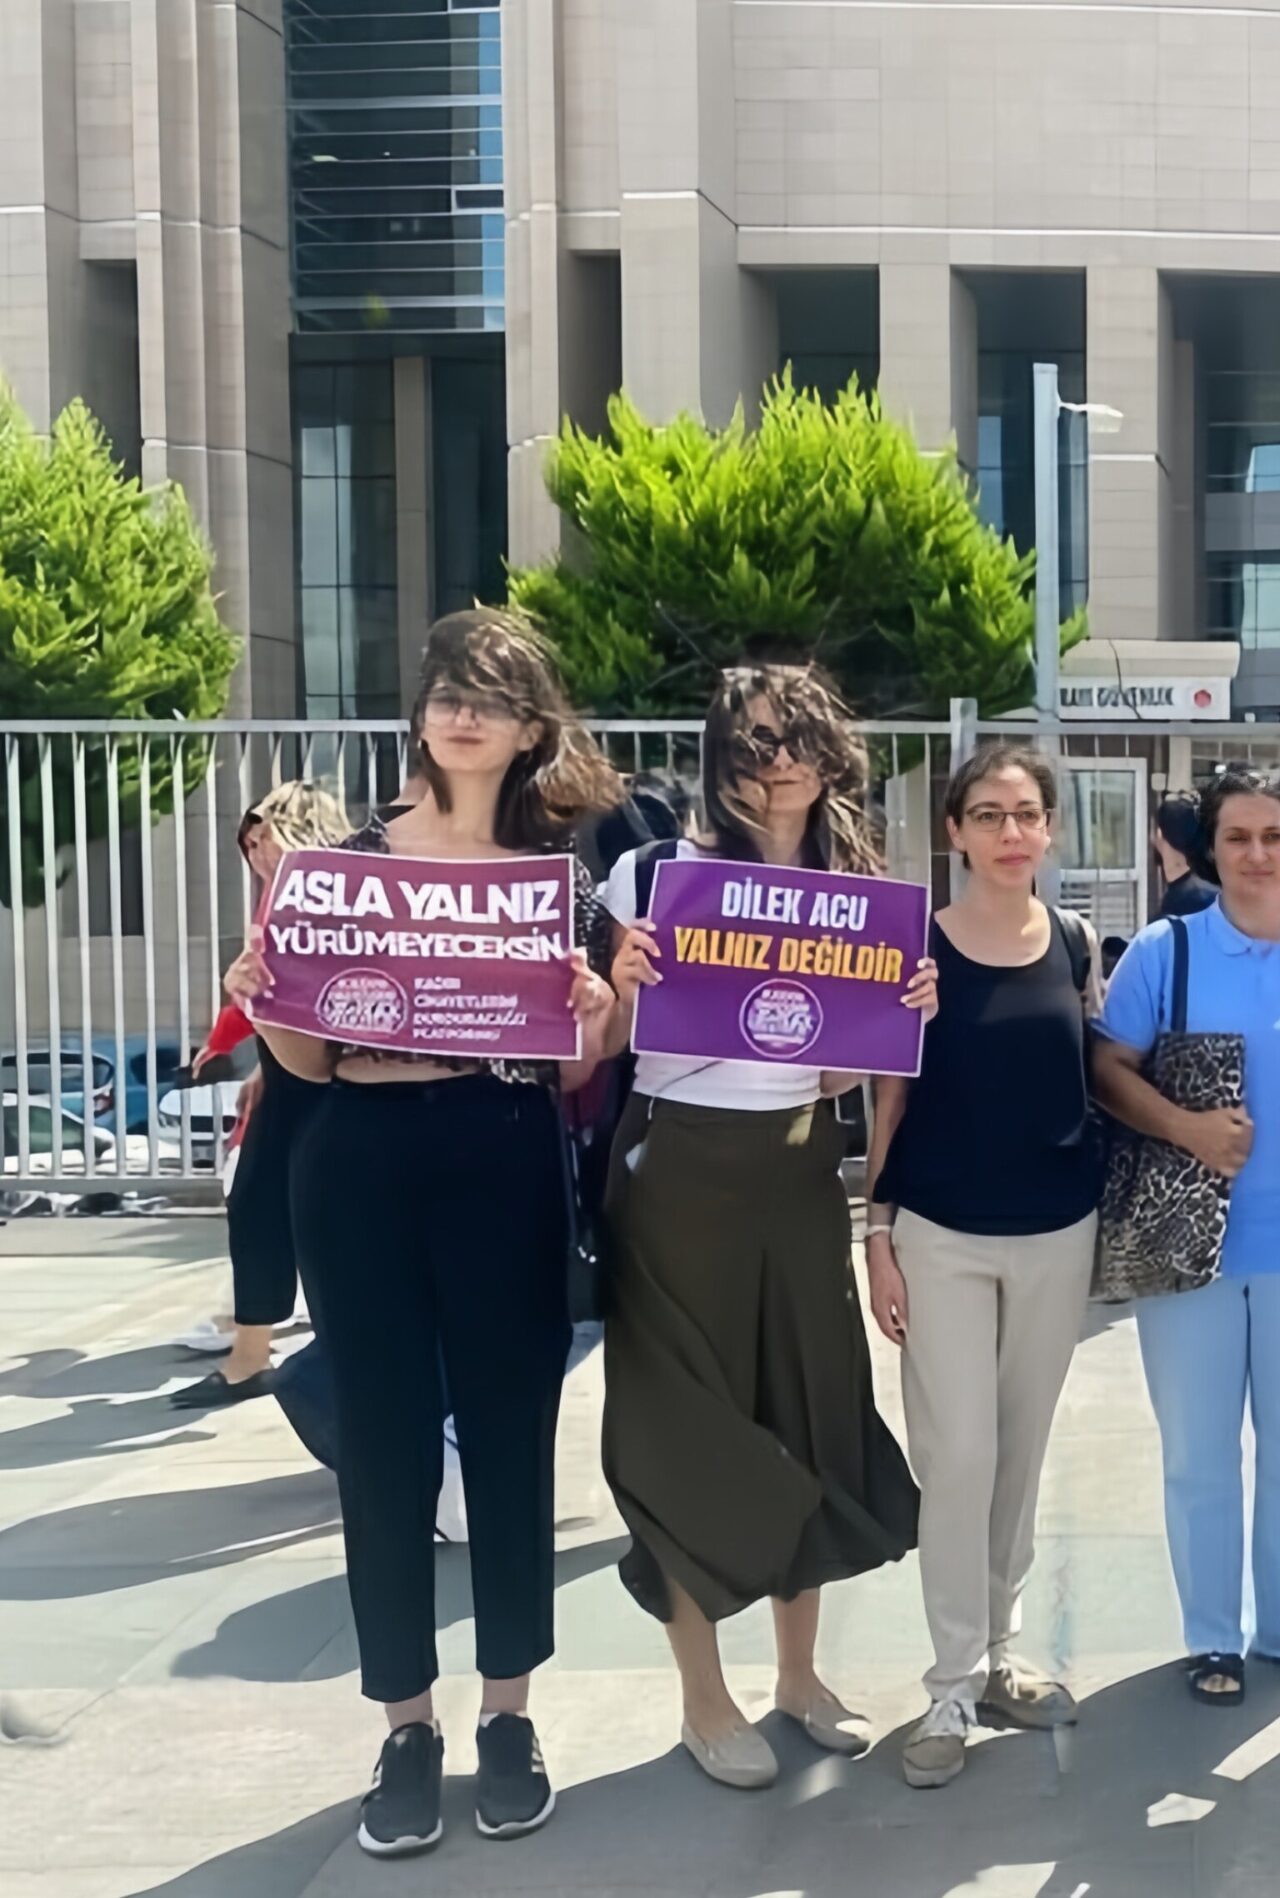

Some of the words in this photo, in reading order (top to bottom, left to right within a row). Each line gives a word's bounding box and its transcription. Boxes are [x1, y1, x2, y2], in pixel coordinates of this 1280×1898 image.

[274, 869, 394, 919] ASLA
[397, 880, 560, 924] YALNIZ
[721, 876, 804, 924] DİLEK
[809, 892, 868, 931] ACU
[268, 920, 570, 961] YÜRÜMEYECEKSİN
[674, 926, 773, 970] YALNIZ
[778, 934, 904, 983] DEĞİLDİR
